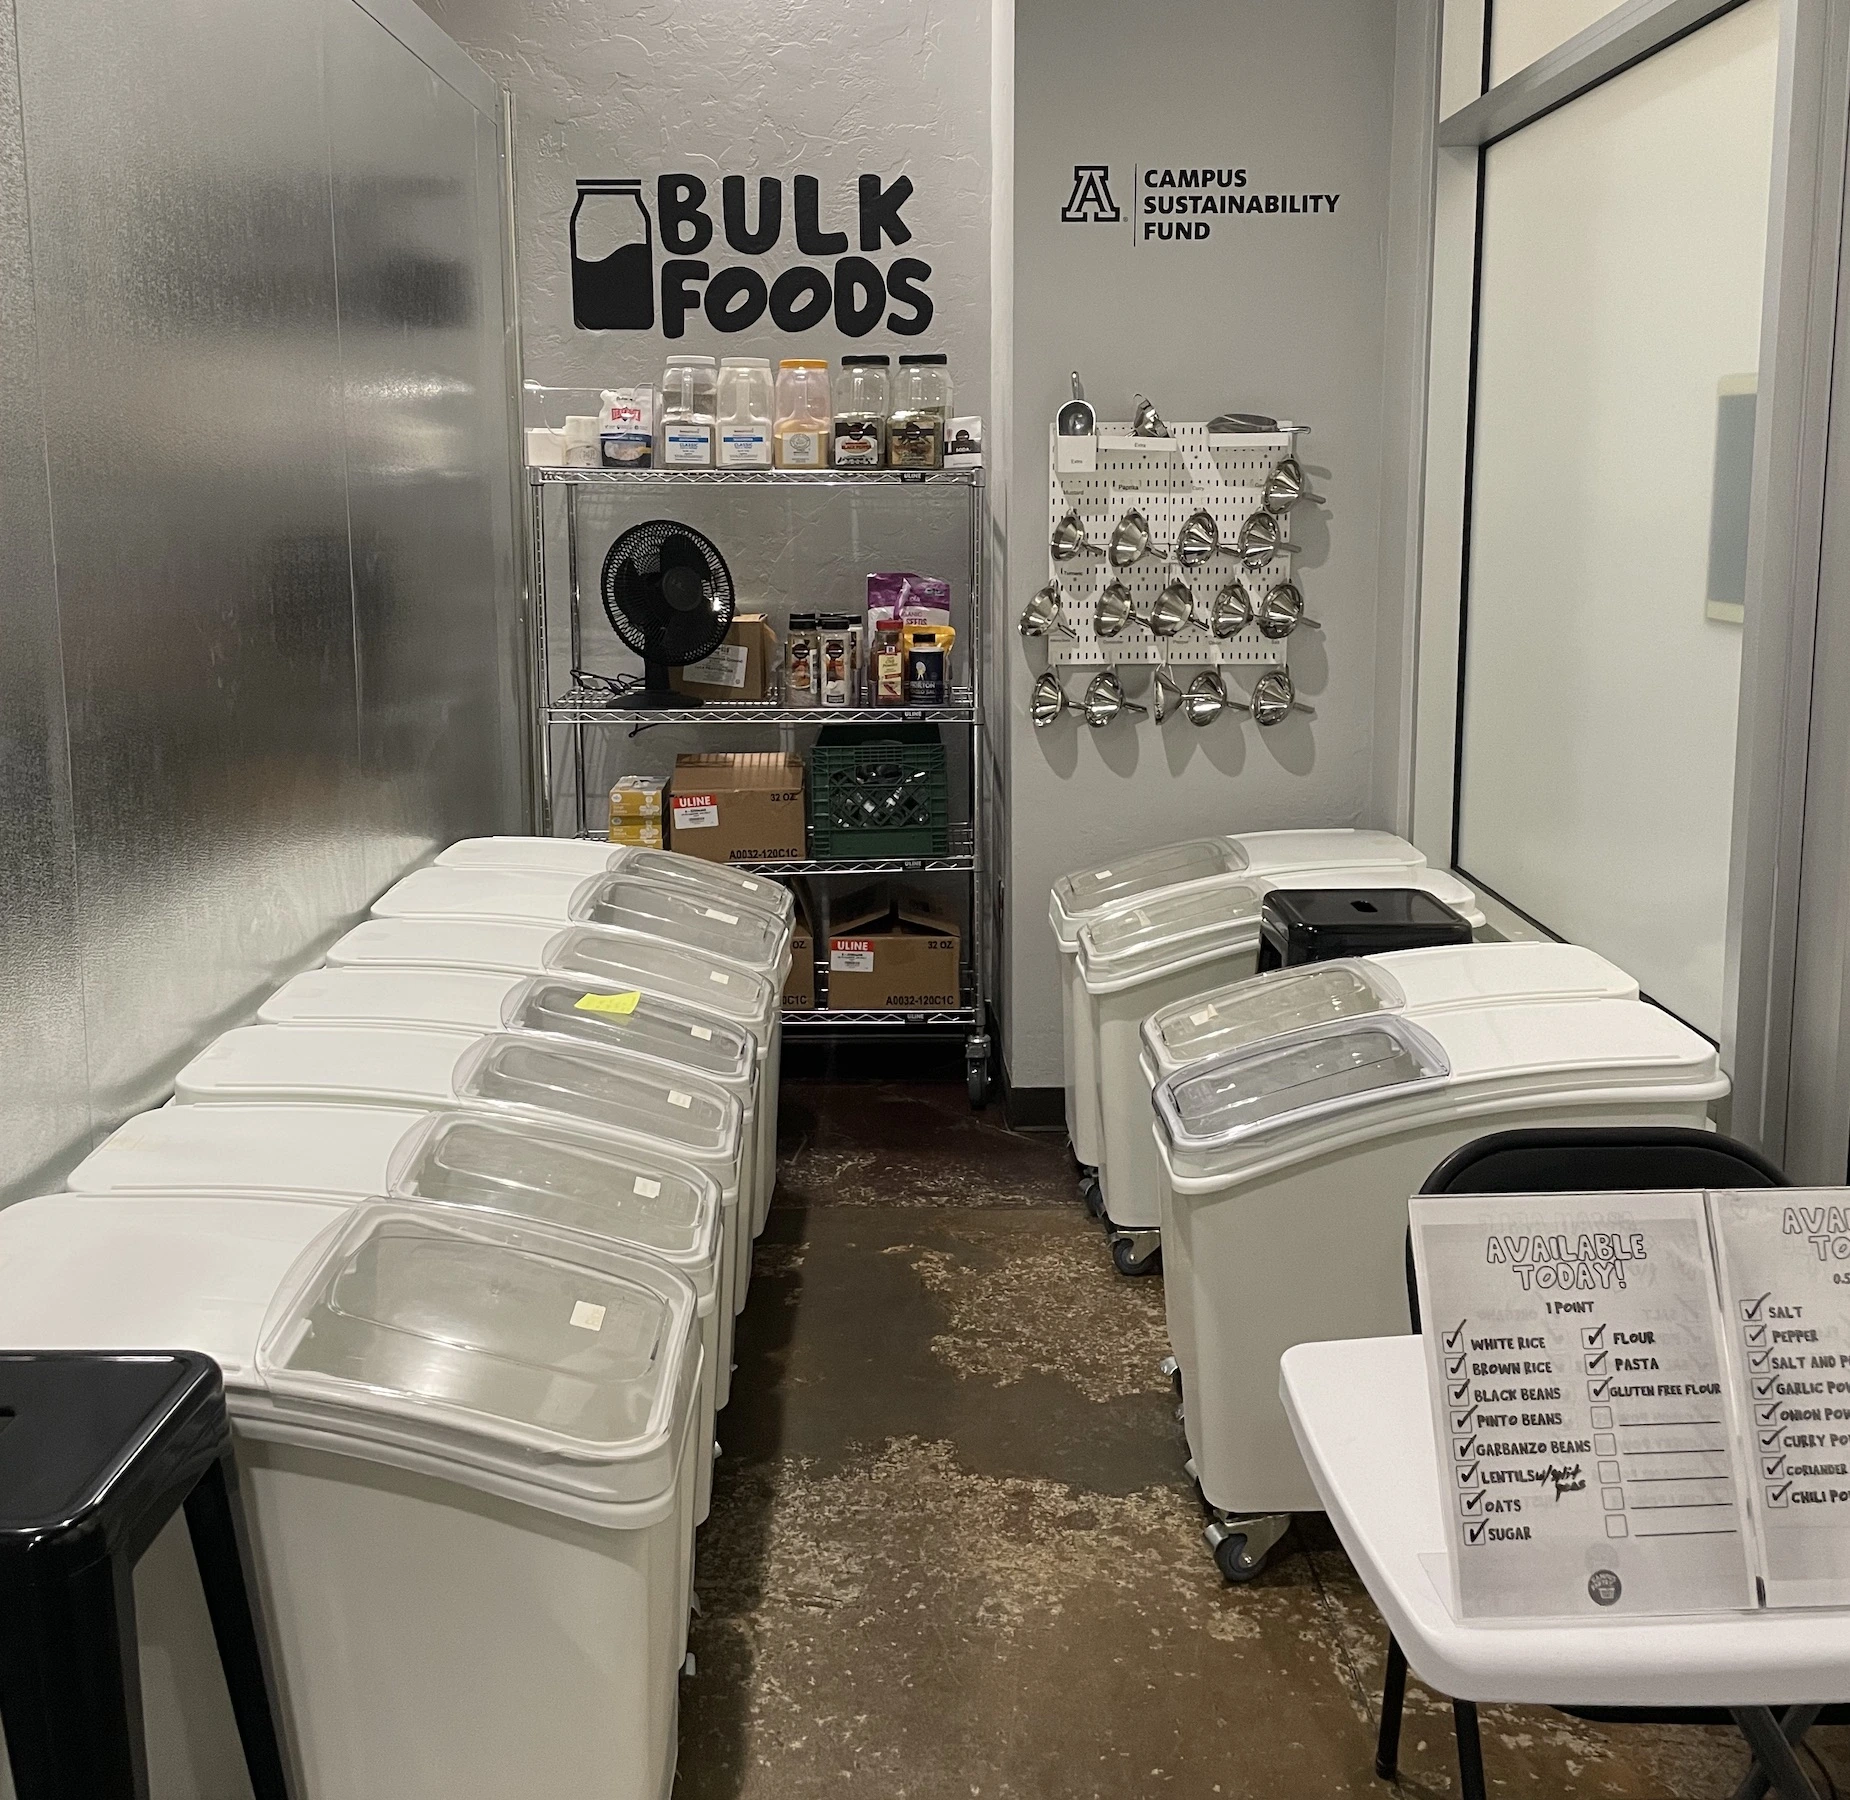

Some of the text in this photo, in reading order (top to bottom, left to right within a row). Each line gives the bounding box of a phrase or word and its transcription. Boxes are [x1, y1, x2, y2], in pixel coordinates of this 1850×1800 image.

[1143, 169, 1247, 188] CAMPUS
[1143, 194, 1340, 214] SUSTAINABILITY
[658, 173, 914, 255] BULK
[1144, 222, 1211, 240] FUND
[661, 256, 934, 339] FOODS
[678, 796, 711, 808] ULINE
[770, 793, 781, 802] 32
[837, 941, 869, 950] ULINE
[927, 940, 938, 949] 32
[1486, 1233, 1647, 1263] AVAILABLE
[1512, 1259, 1627, 1290] TODAY!
[1555, 1301, 1594, 1315] POINT
[1768, 1306, 1803, 1319] SALT
[1613, 1331, 1656, 1345] FLOUR
[1772, 1329, 1819, 1343] PEPPER
[1470, 1336, 1546, 1351] WHITE RICE
[1472, 1361, 1553, 1376] BROWN RICE
[1615, 1357, 1660, 1371] PASTA
[1771, 1356, 1806, 1369] SALT
[1811, 1355, 1837, 1369] AND
[1474, 1387, 1561, 1402] BLACK BEANS
[1610, 1383, 1722, 1397] GLUTEN FREE FLOUR
[1776, 1382, 1824, 1395] GARLIC
[1477, 1413, 1563, 1428] PINTO BEANS
[1780, 1408, 1822, 1421] ONION
[1783, 1433, 1850, 1447] CURRY PO
[1476, 1440, 1592, 1456] GARBANZO BEANS
[1481, 1470, 1536, 1484] LENTILS
[1786, 1463, 1848, 1477] CORIANDER
[1791, 1489, 1850, 1503] CHILI PO
[1485, 1499, 1521, 1513] OATS
[1488, 1526, 1532, 1541] SUGAR
